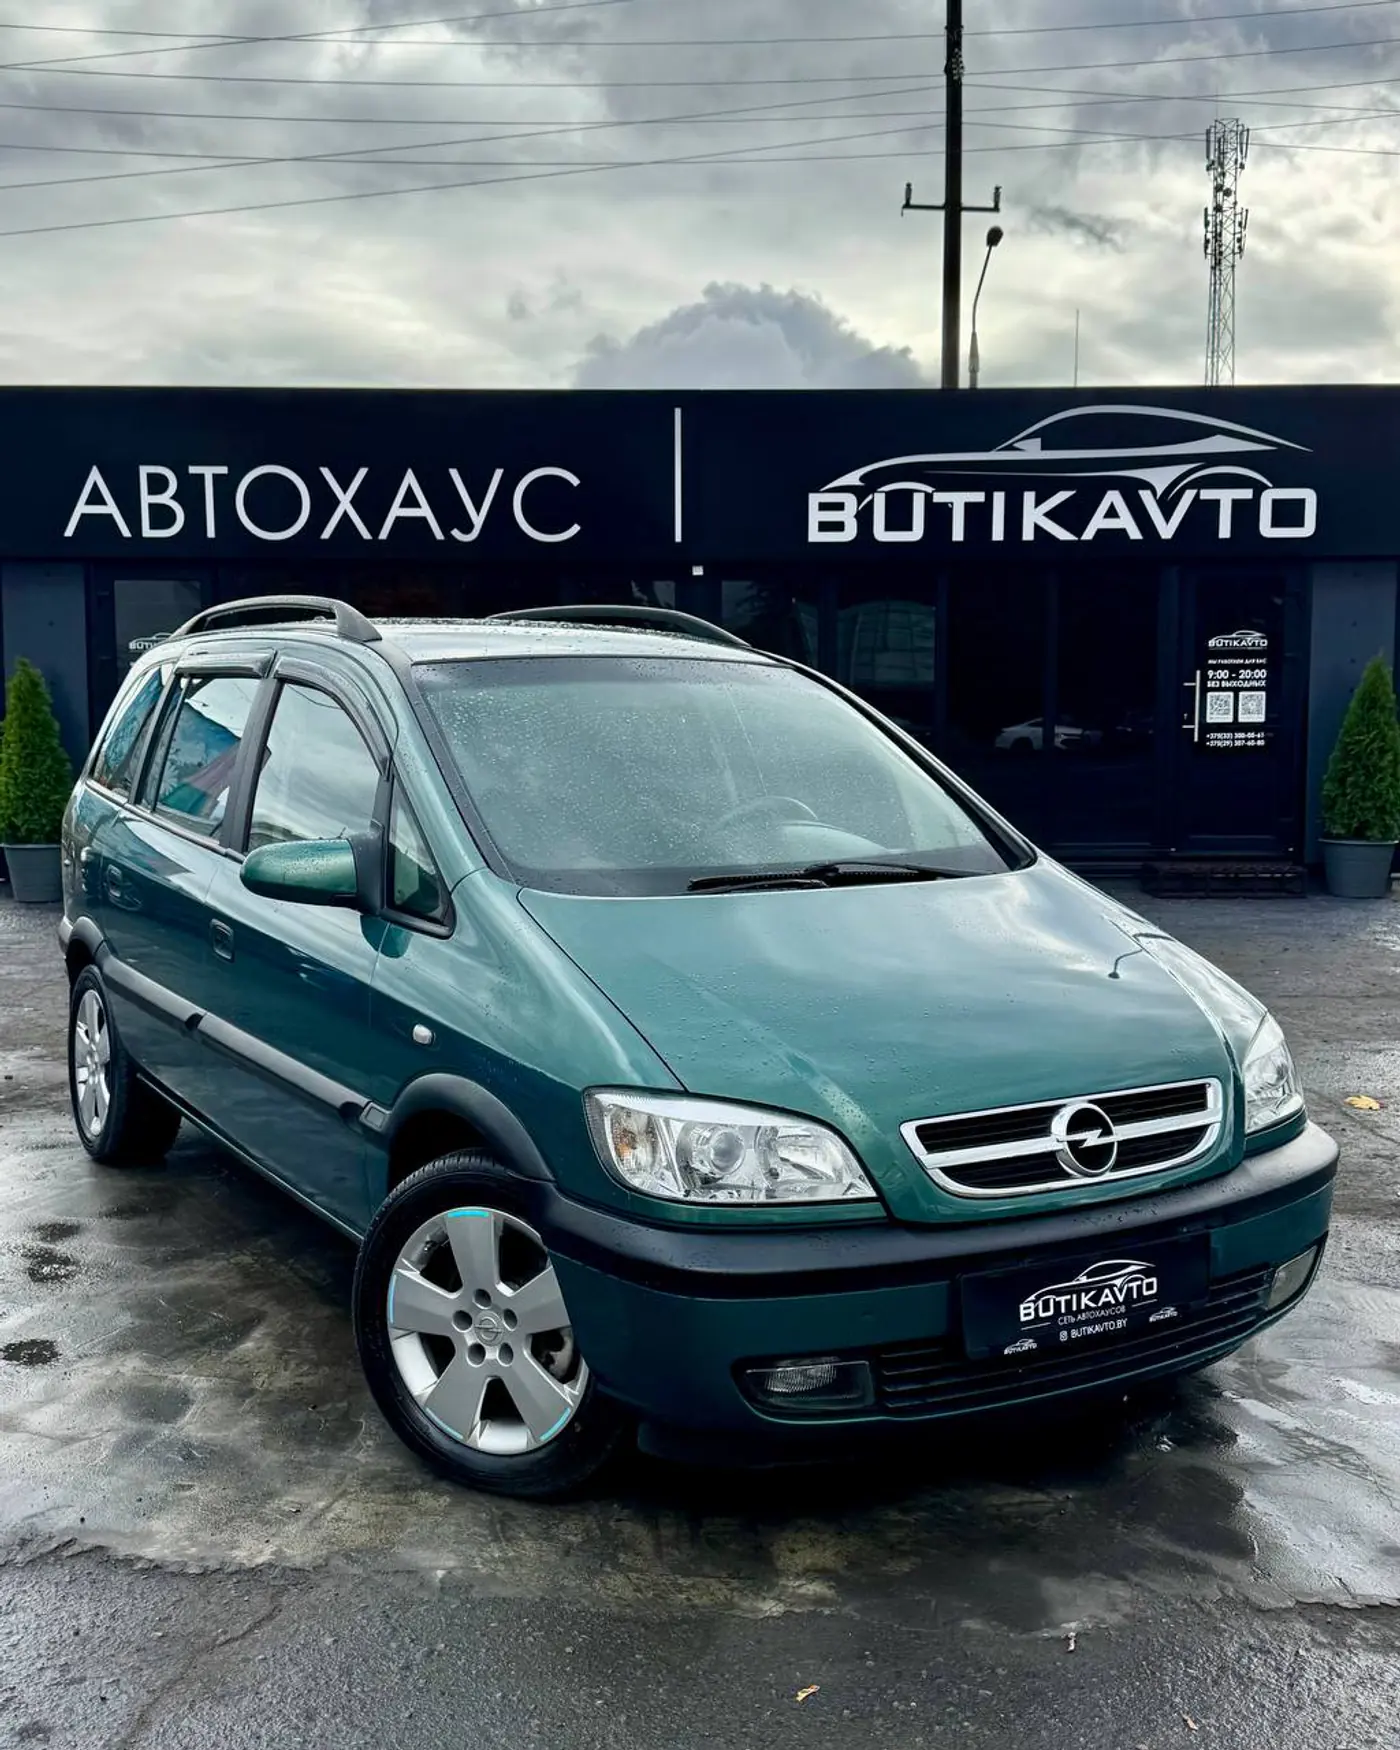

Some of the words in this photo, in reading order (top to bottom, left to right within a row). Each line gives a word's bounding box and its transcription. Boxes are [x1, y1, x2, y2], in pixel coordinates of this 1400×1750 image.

[63, 464, 582, 544] АВТОХАУС
[807, 485, 1318, 543] BUTIKAVTO
[1208, 638, 1268, 647] BUTIKAVTO
[1207, 669, 1230, 680] 9:00
[1238, 669, 1268, 679] 20:00
[1019, 1276, 1158, 1322] BUTIKAVTO
[1058, 1314, 1076, 1326] СЕТЬ
[1076, 1305, 1126, 1322] АВТОХАУСОВ
[1070, 1318, 1128, 1339] BUTIKAVTO.BY
